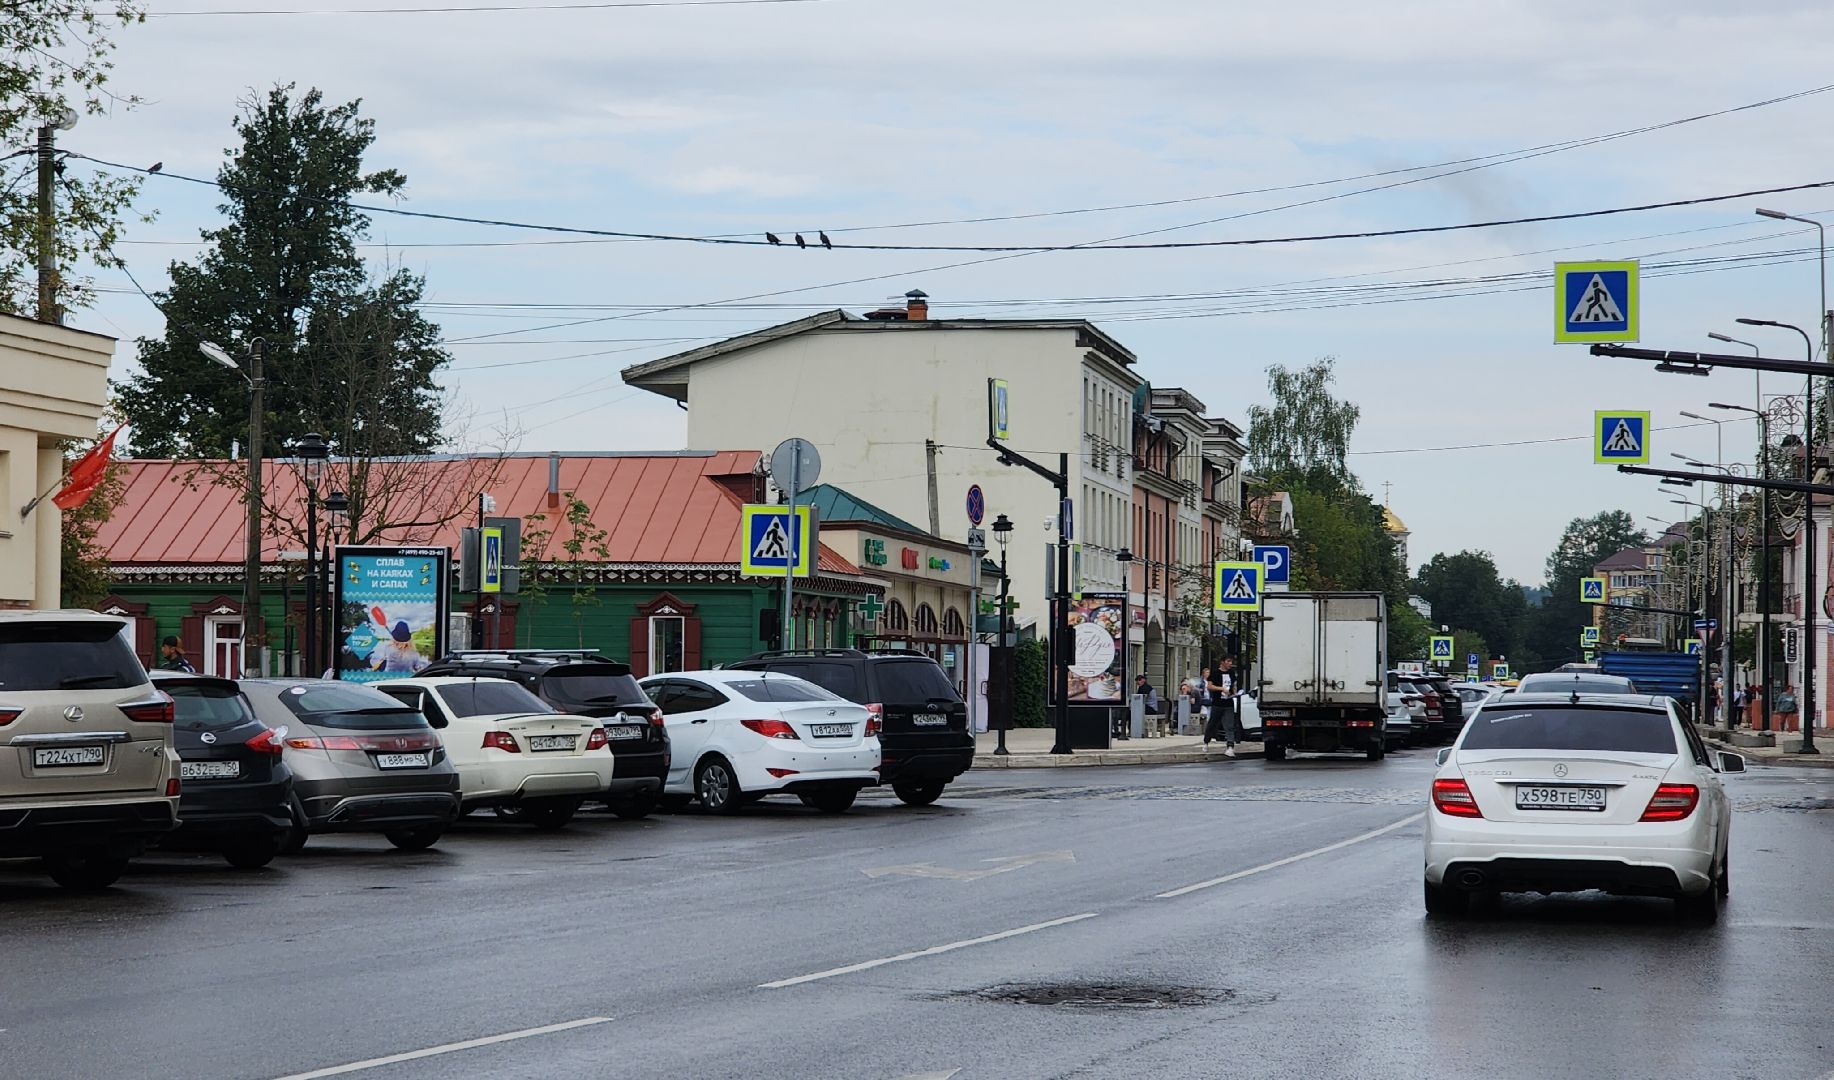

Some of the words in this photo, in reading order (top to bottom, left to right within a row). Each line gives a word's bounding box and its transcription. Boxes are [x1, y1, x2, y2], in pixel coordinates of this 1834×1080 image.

[376, 558, 405, 567] СПЛАВ
[1263, 551, 1282, 578] P
[380, 570, 414, 578] КАЯКАХ
